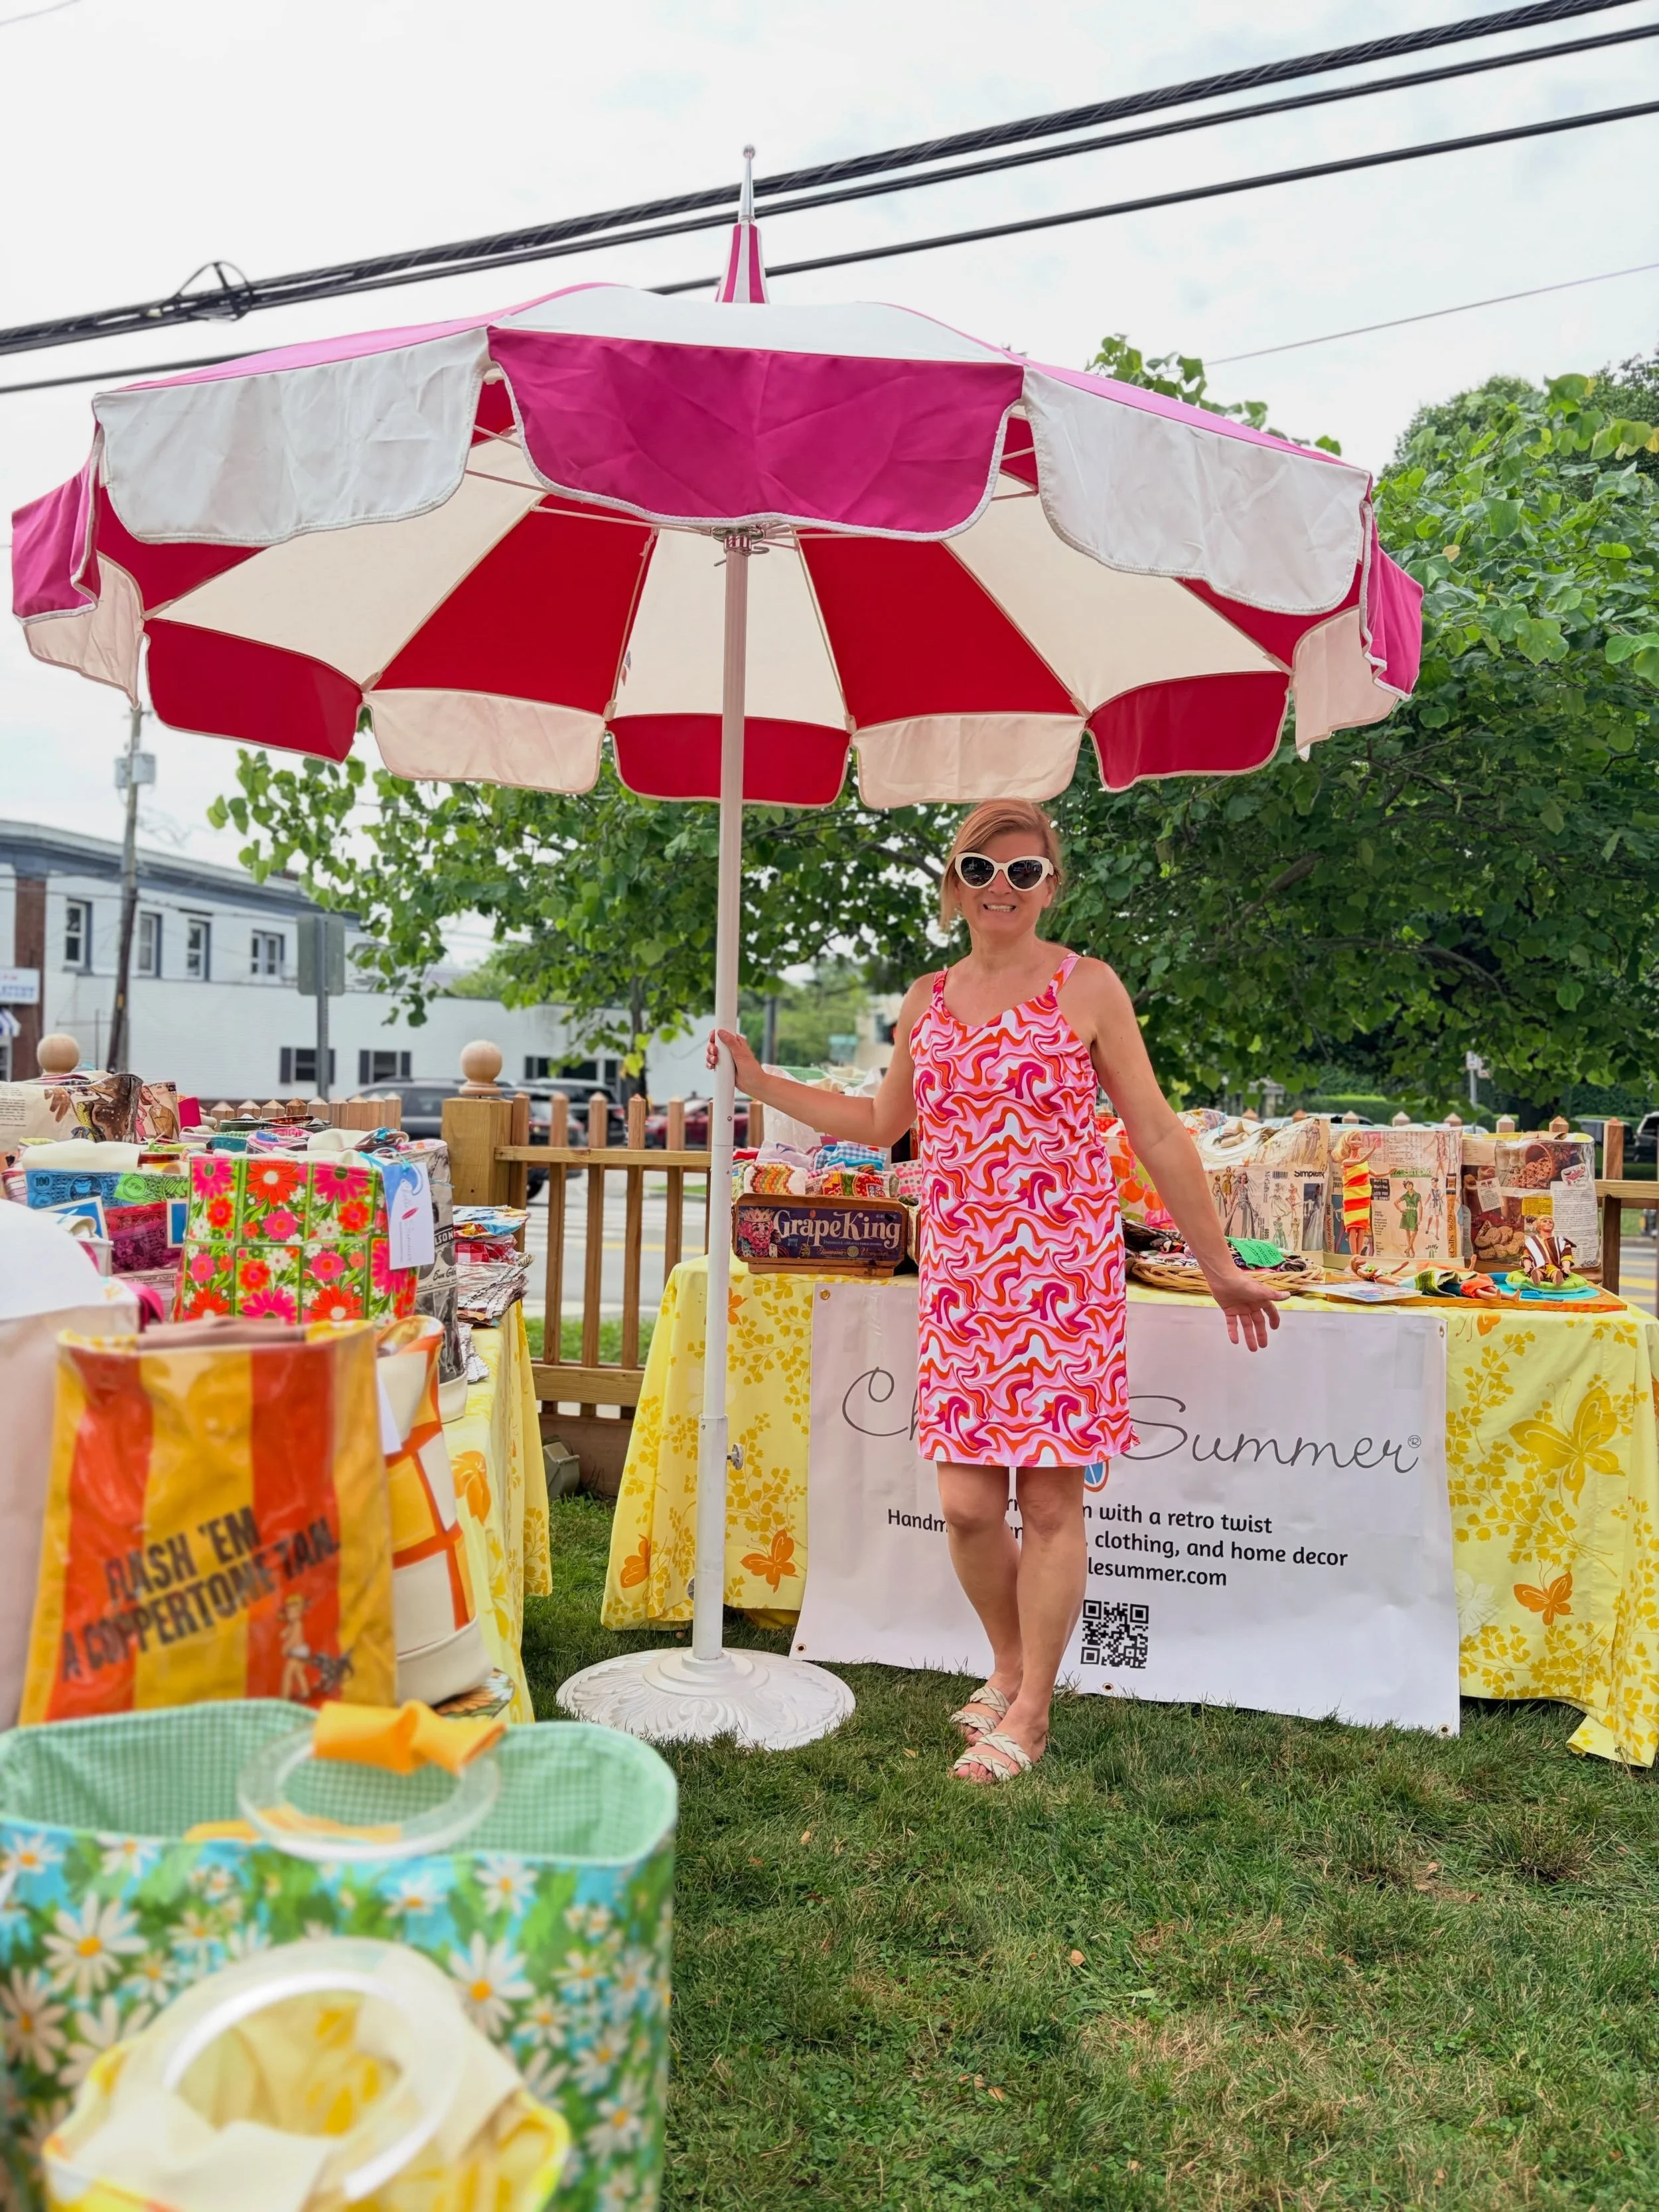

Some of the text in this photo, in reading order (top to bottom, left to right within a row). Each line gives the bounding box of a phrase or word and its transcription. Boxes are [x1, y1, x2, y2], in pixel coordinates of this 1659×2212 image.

[35, 1176, 50, 1187] 100
[434, 1230, 455, 1246] LSON
[1099, 1503, 1143, 1524] with
[1149, 1511, 1161, 1526] a
[1167, 1511, 1215, 1530] retro
[1220, 1514, 1273, 1534] twist
[887, 1508, 1348, 1567] Handm clothing, and home decor
[1087, 1556, 1227, 1587] lesummer.com
[62, 1630, 82, 1682] A
[82, 1552, 276, 1672] COPPERTONE
